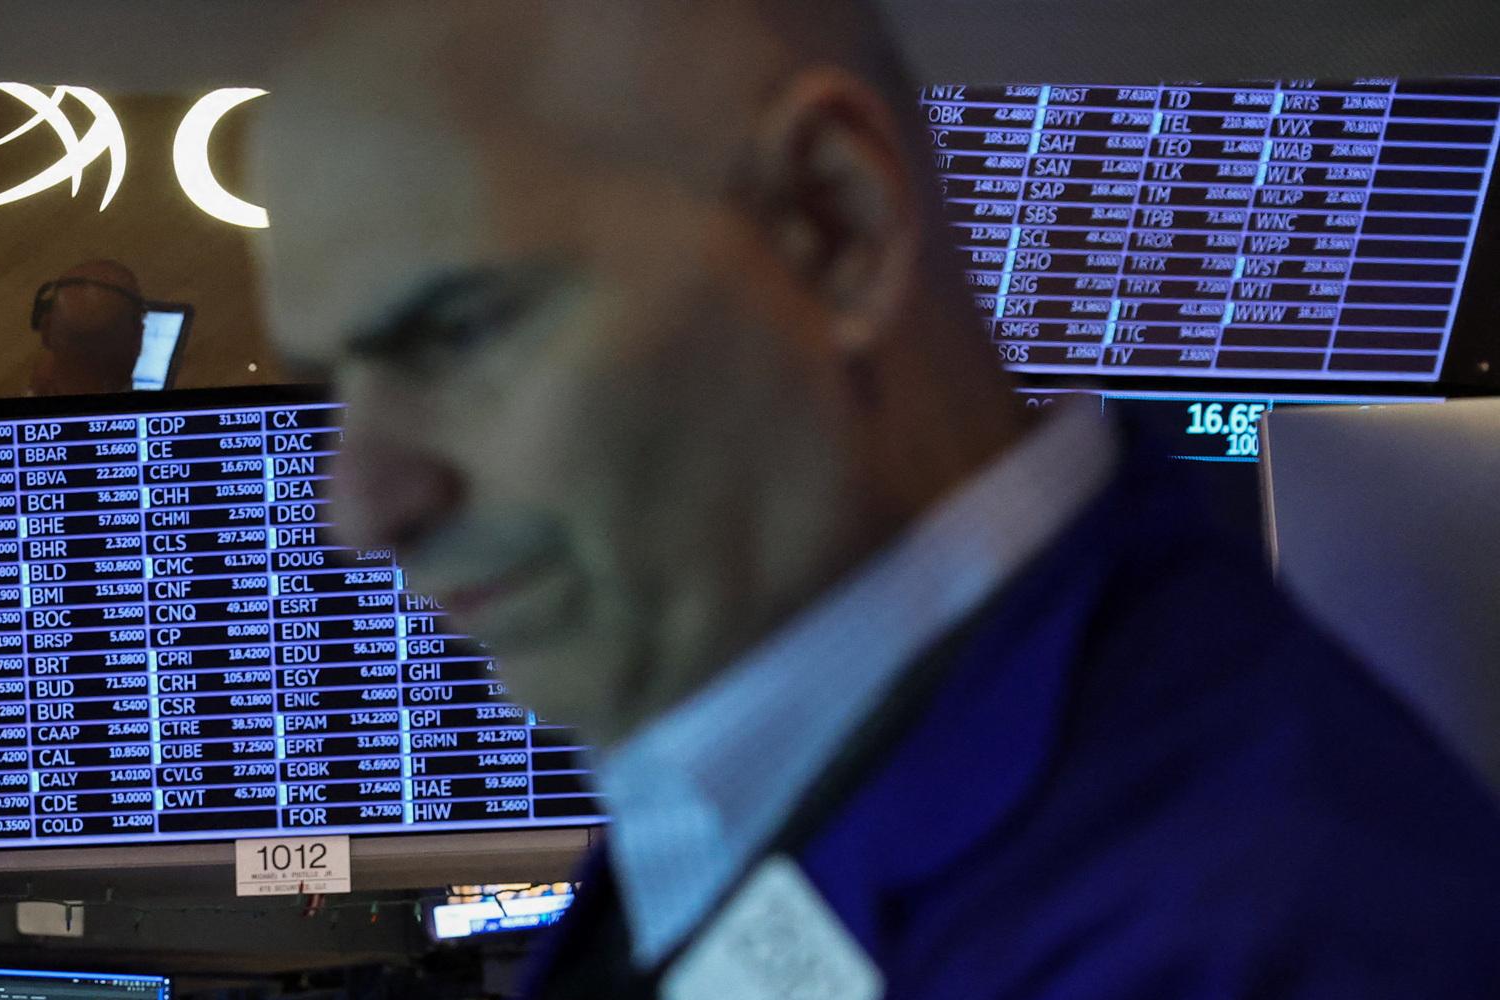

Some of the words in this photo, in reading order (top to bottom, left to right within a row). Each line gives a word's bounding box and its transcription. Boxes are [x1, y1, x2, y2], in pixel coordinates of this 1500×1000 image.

[932, 86, 965, 99] NTZ
[1051, 89, 1089, 101] RNST
[1168, 91, 1190, 109] TD
[1284, 96, 1320, 111] VRTS
[1046, 112, 1083, 125] RVTY
[1162, 115, 1191, 132] TEL
[1040, 135, 1076, 152] SAH
[1157, 138, 1191, 156] TEO
[1273, 143, 1313, 160] WAB
[1034, 159, 1071, 176] SAN
[1152, 163, 1184, 180] TLK
[1267, 167, 1304, 183] WLK
[1030, 183, 1064, 199] SAP
[1025, 206, 1058, 223] SBS
[1142, 211, 1174, 227] TPB
[1256, 214, 1298, 230] WNC
[1020, 230, 1050, 246] SCL
[1251, 237, 1290, 252] WPP
[1015, 254, 1051, 270] SHO
[1010, 277, 1038, 292] SIG
[1004, 300, 1037, 316] SKT
[1236, 306, 1286, 321] WWW
[1002, 323, 1039, 337] SMFG
[149, 419, 185, 434] CDP
[220, 414, 260, 425] 31.3100
[274, 412, 297, 428] CX
[1186, 403, 1264, 435] 16.65
[25, 425, 61, 441] BAP
[88, 421, 135, 432] 337.4400
[1226, 434, 1259, 456] 100
[151, 466, 189, 480] CEPU
[276, 459, 314, 474] DAN
[27, 472, 66, 486] BBVA
[96, 467, 137, 479] 22.2200
[153, 512, 189, 526] CHMI
[230, 507, 264, 518] 2.5700
[278, 505, 315, 521] DEO
[29, 517, 64, 533] BHE
[98, 514, 139, 525] 57.0300
[155, 558, 193, 574] CMC
[280, 553, 324, 567] DOUG
[31, 564, 66, 579] BLD
[281, 576, 314, 591] ECL
[157, 605, 196, 620] CNQ
[282, 599, 318, 613] ESRT
[359, 596, 393, 607] 5.1100
[33, 610, 71, 625] BOC
[407, 620, 433, 635] FTI
[159, 652, 192, 666] CPRI
[284, 646, 319, 661] EDU
[36, 656, 69, 672] BRT
[409, 666, 440, 681] GHI
[38, 702, 74, 718] BUR
[113, 699, 147, 710] 4.5400
[161, 698, 195, 713] CSR
[287, 716, 327, 730] EPAM
[411, 712, 440, 727] GPI
[412, 735, 457, 748] GRMN
[40, 749, 75, 764] CAL
[163, 745, 202, 759] CUBE
[290, 786, 326, 801] FMC
[413, 780, 451, 796] HAE
[42, 795, 77, 810] CDE
[110, 791, 151, 803] 19.0000
[165, 791, 204, 806] CWT
[235, 787, 275, 799] 45.7100
[291, 809, 326, 825] FOR
[414, 804, 451, 819] HIW
[43, 818, 83, 832] COLD
[257, 843, 327, 870] 1012
